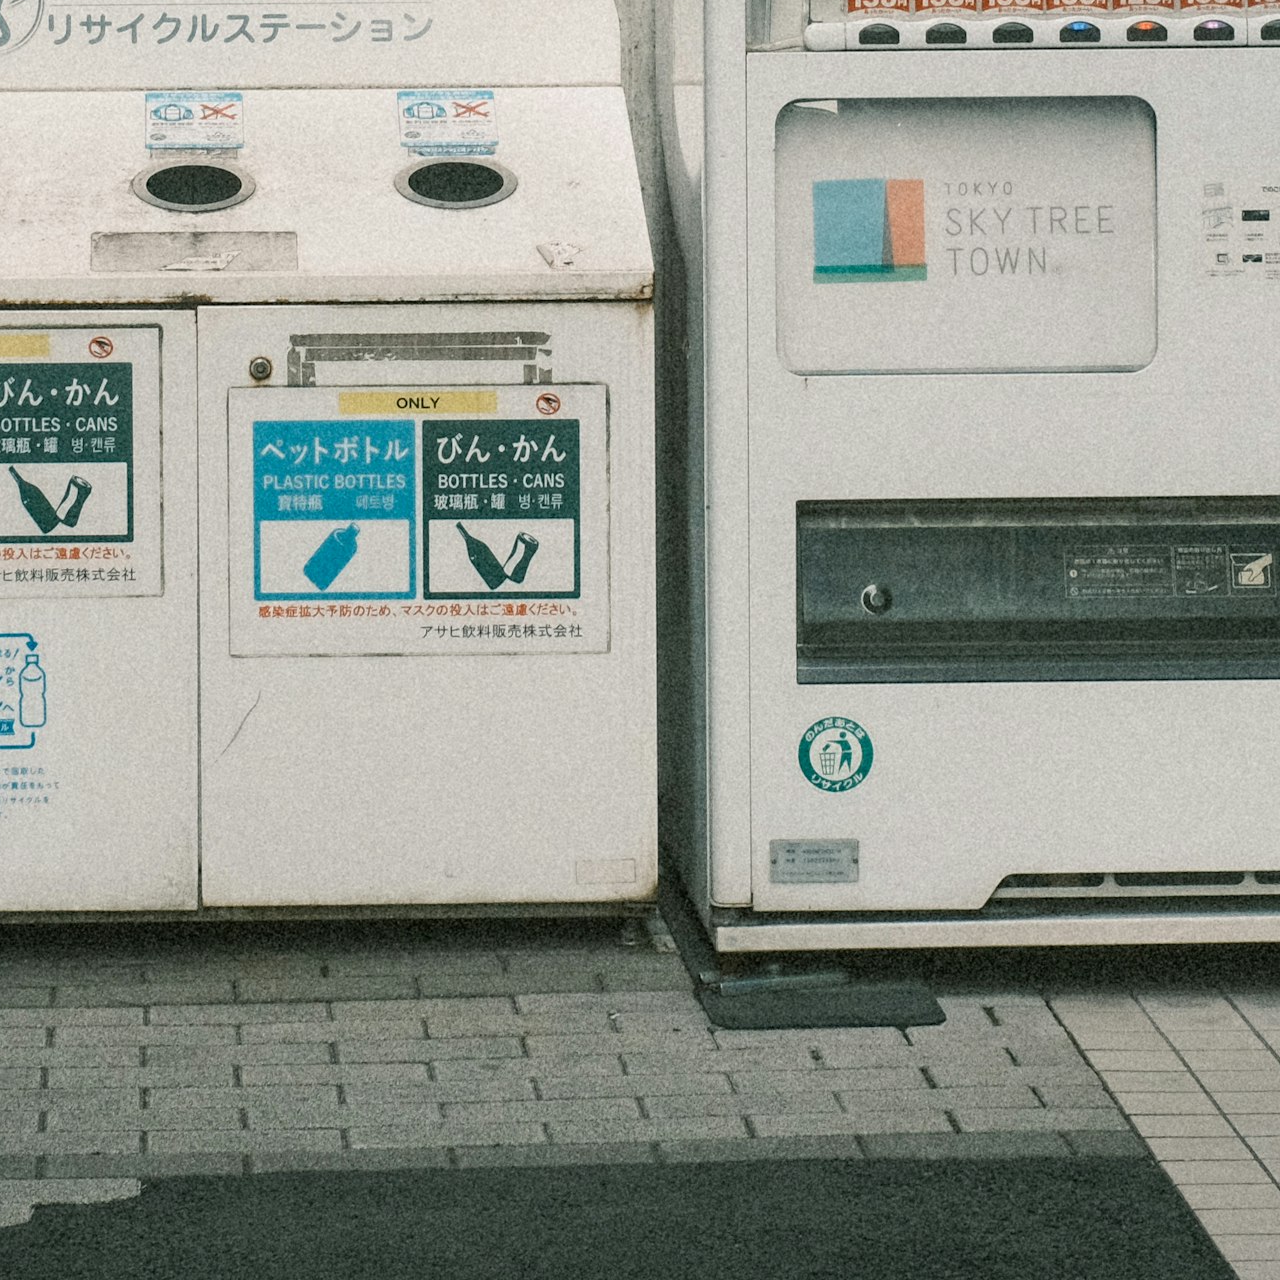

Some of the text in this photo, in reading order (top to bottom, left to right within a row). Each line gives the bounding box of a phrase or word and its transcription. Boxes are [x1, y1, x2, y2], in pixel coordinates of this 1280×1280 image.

[48, 12, 434, 45] リサイクルステーション
[943, 181, 1014, 197] TOKYO
[946, 247, 1049, 276] TOWN
[396, 397, 440, 410] ONLY
[260, 435, 409, 465] ペットボトル
[437, 434, 567, 464] びん・かん
[263, 474, 406, 490] PLASTIC BOTTLES
[420, 624, 583, 639] アサヒ飲料販売株式会社
[805, 717, 867, 743] のんだあとは
[811, 771, 865, 792] リサイクル
